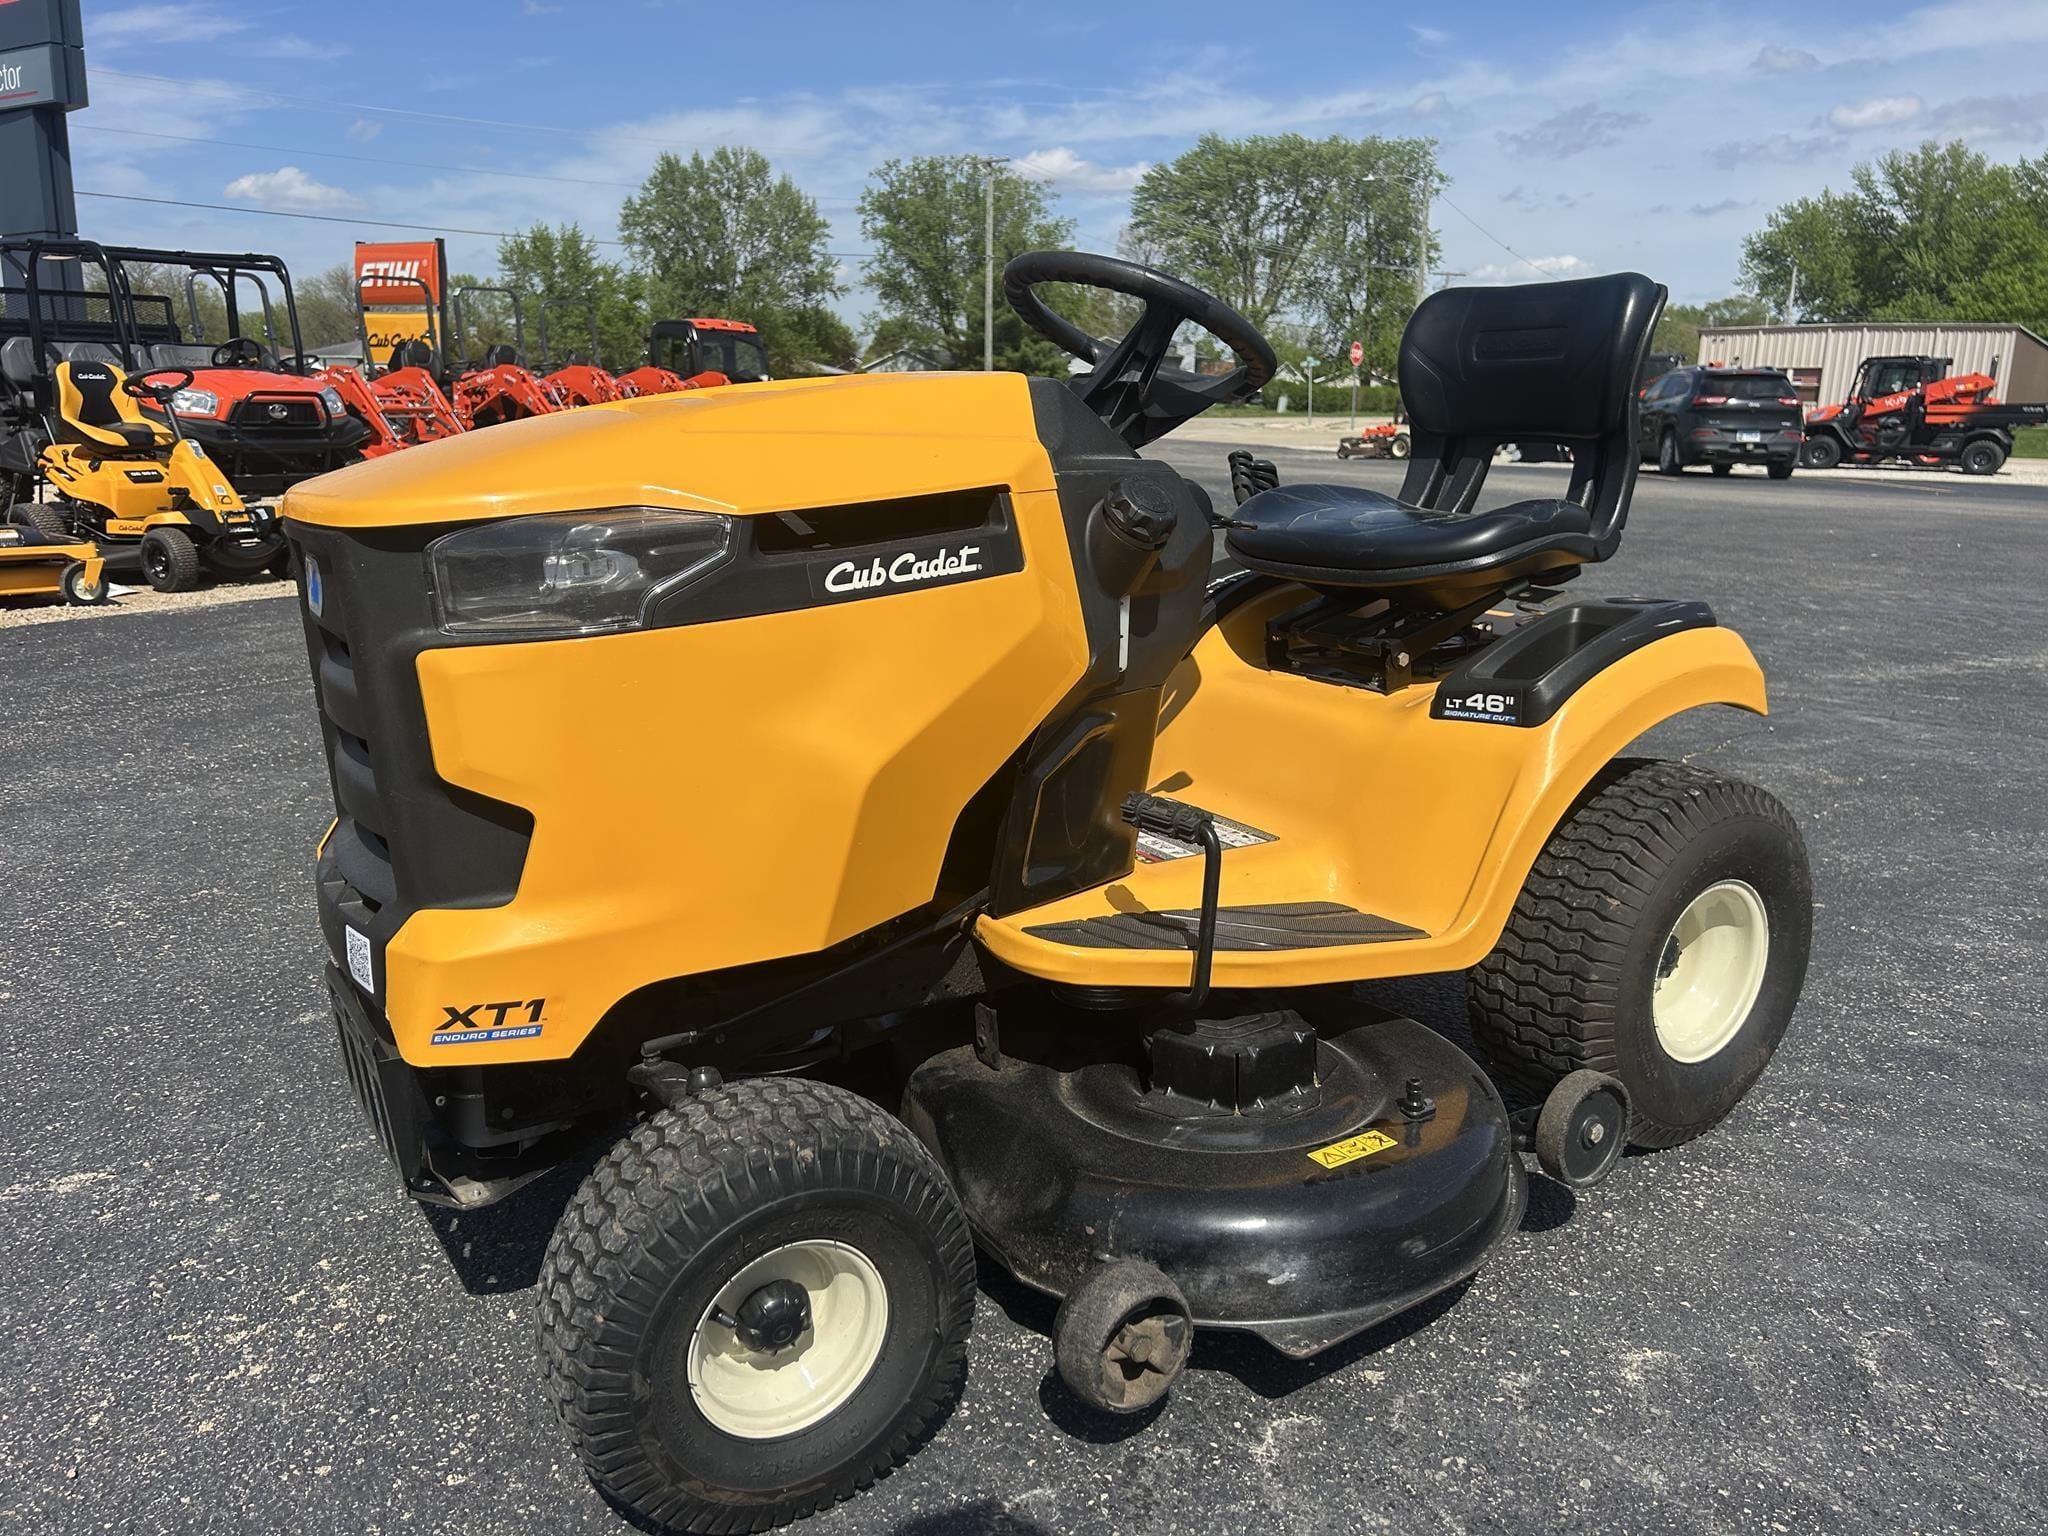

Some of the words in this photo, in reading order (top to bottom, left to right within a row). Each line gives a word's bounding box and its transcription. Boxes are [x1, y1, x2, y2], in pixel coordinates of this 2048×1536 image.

[361, 261, 420, 287] STIHL
[368, 333, 389, 348] Cub
[825, 558, 887, 593] Cub
[888, 546, 980, 583] Cadet
[1446, 698, 1463, 709] LT
[1465, 693, 1515, 713] 46"
[1444, 710, 1491, 720] SIGNATURE
[1492, 714, 1511, 722] CUT
[434, 998, 546, 1031] XT1
[433, 1032, 488, 1043] ENDURO
[491, 1027, 537, 1039] SERIES
